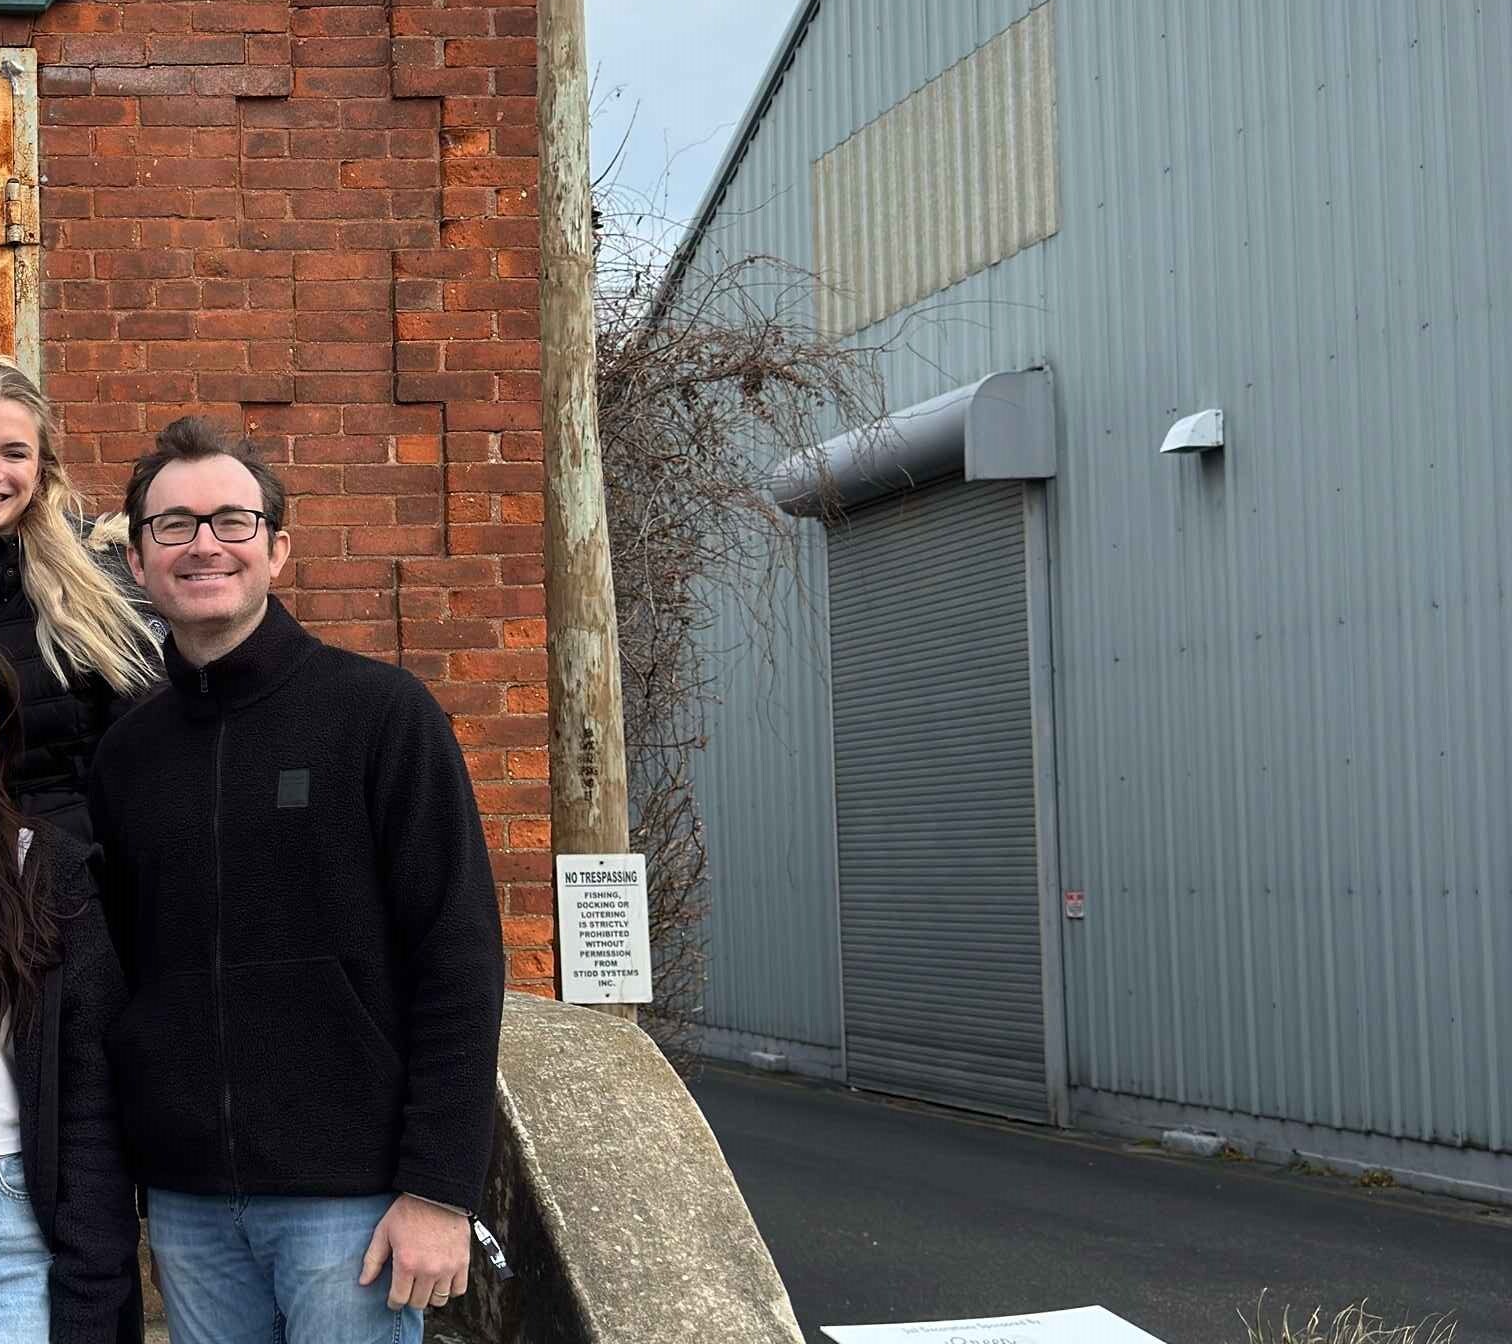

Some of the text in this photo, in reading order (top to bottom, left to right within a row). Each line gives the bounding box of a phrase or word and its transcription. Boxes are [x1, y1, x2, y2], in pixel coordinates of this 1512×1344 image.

[565, 871, 638, 884] NO TRESPASSING
[584, 891, 622, 900] FISHING,
[577, 901, 630, 909] DOCKING OR
[581, 911, 626, 919] LOITERING
[589, 920, 629, 928] STRICTLY
[579, 930, 630, 938] PROHIBITED
[585, 940, 625, 948] WITHOUT
[580, 950, 631, 958] PERMISSION
[600, 969, 639, 977] SYSTEMS
[598, 979, 616, 987] INC.
